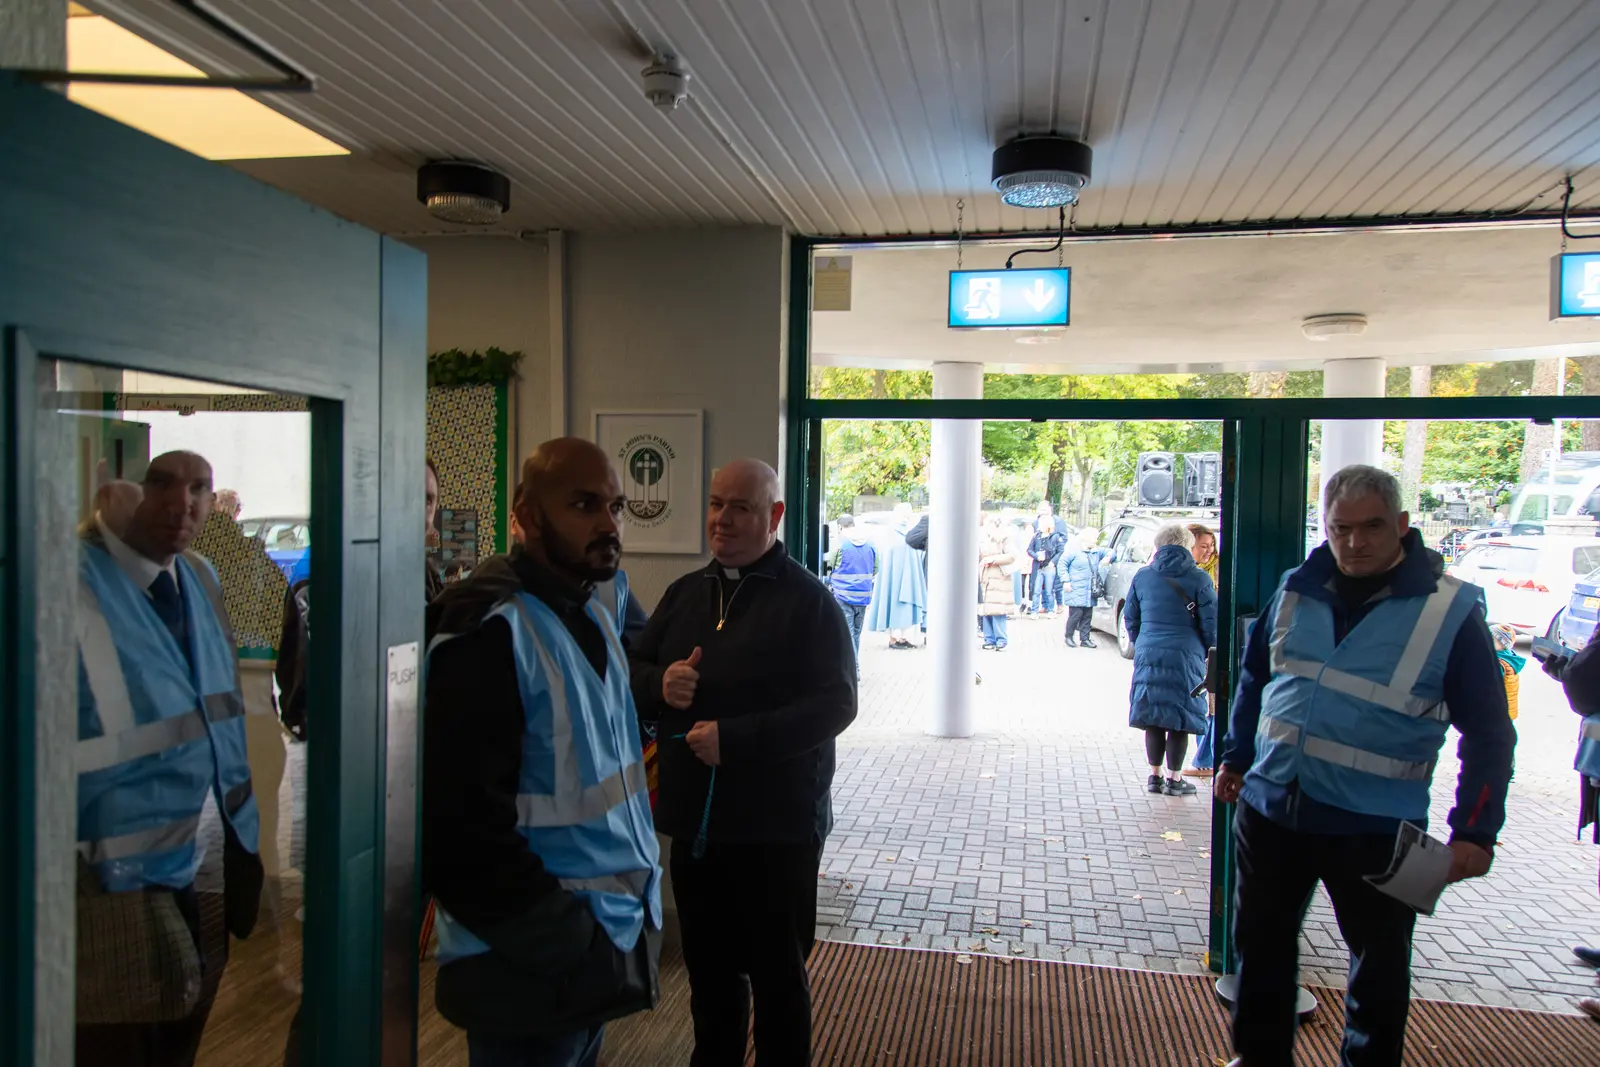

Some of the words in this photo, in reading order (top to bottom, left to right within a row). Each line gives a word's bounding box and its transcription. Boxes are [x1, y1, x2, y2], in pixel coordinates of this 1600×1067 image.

[618, 447, 626, 459] ST
[653, 435, 676, 459] PARISH
[389, 666, 416, 685] PUSH
